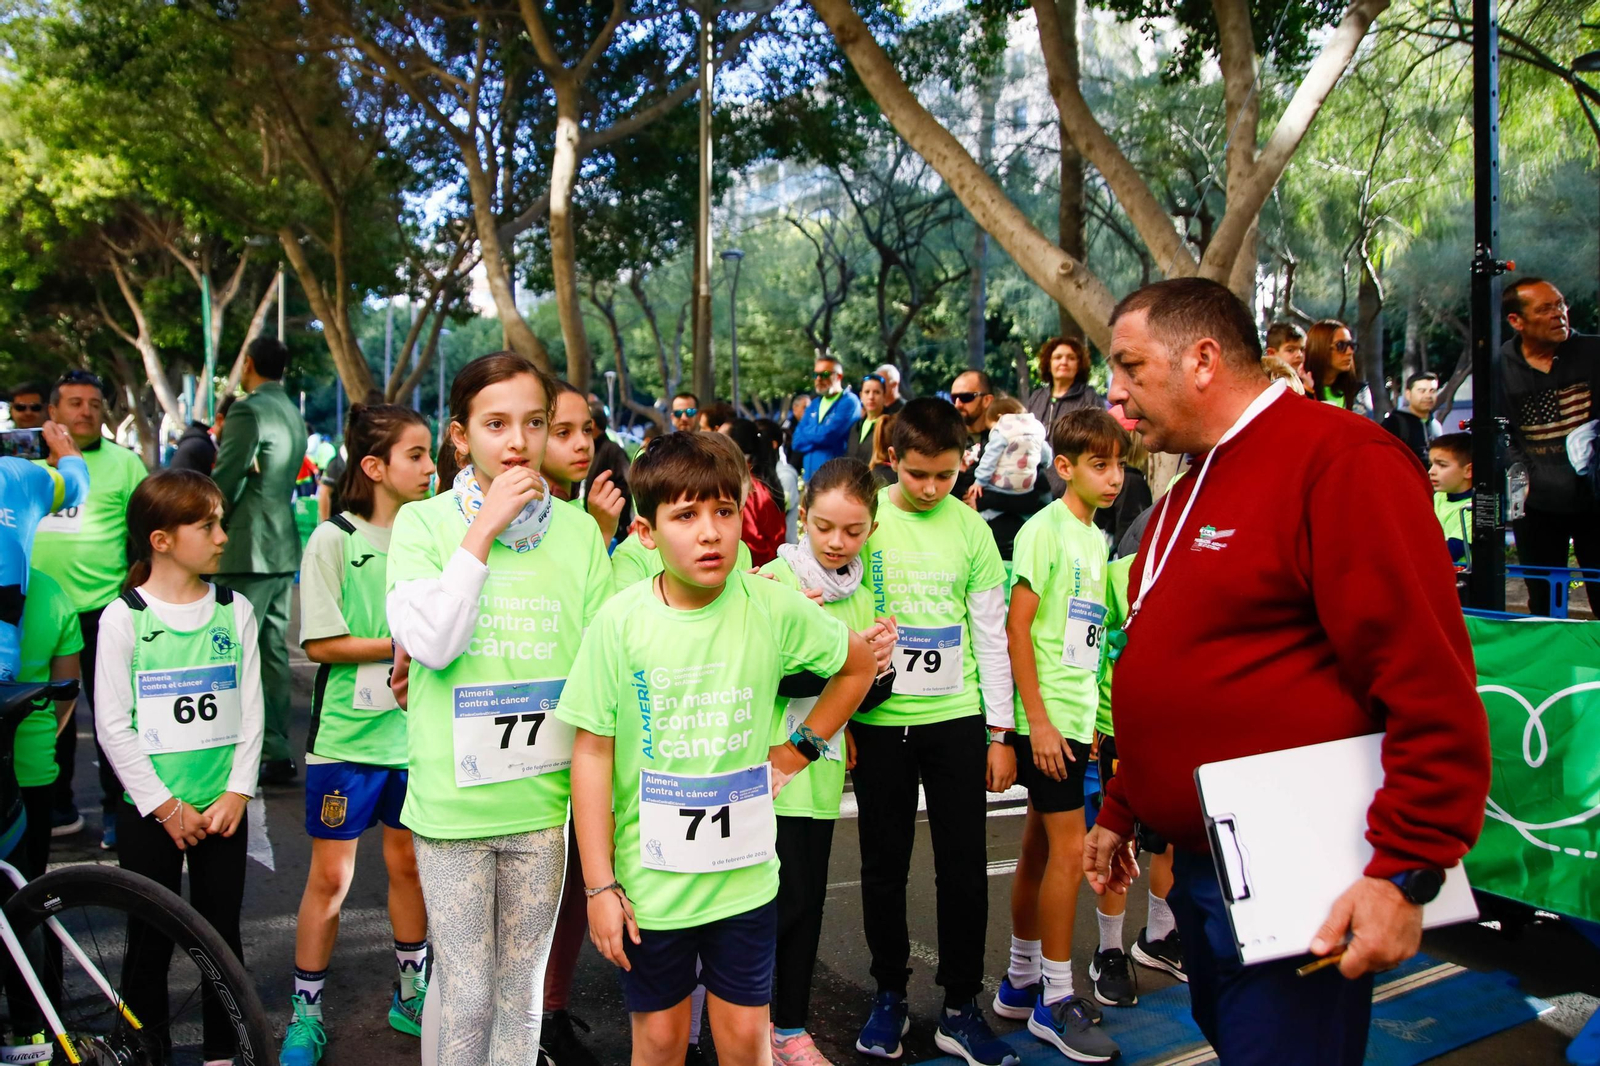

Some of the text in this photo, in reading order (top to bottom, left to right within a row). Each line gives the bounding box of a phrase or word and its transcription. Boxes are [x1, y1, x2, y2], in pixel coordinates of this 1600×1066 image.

[869, 550, 885, 613] ALMERÍA
[886, 567, 956, 582] En marcha
[887, 581, 952, 596] contra el
[478, 594, 561, 612] n marcha
[889, 596, 954, 615] cáncer
[476, 612, 559, 633] ontra el
[467, 631, 557, 660] cáncer
[909, 635, 931, 643] cáncer
[903, 649, 942, 673] 79
[142, 674, 172, 683] Almería
[142, 682, 167, 691] contra
[177, 680, 203, 688] cáncer
[459, 689, 494, 699] Almería
[459, 696, 529, 708] contra el cáncer
[653, 686, 753, 711] En marcha
[173, 693, 218, 724] 66
[632, 670, 654, 759] ALMERÍA
[655, 701, 752, 730] contra el
[494, 712, 546, 750] 77
[658, 729, 752, 759] cáncer
[533, 762, 553, 771] febrero
[645, 775, 679, 787] Almería
[645, 786, 673, 796] contra
[686, 789, 718, 798] cáncer
[679, 805, 730, 841] 71
[725, 854, 745, 864] febrero
